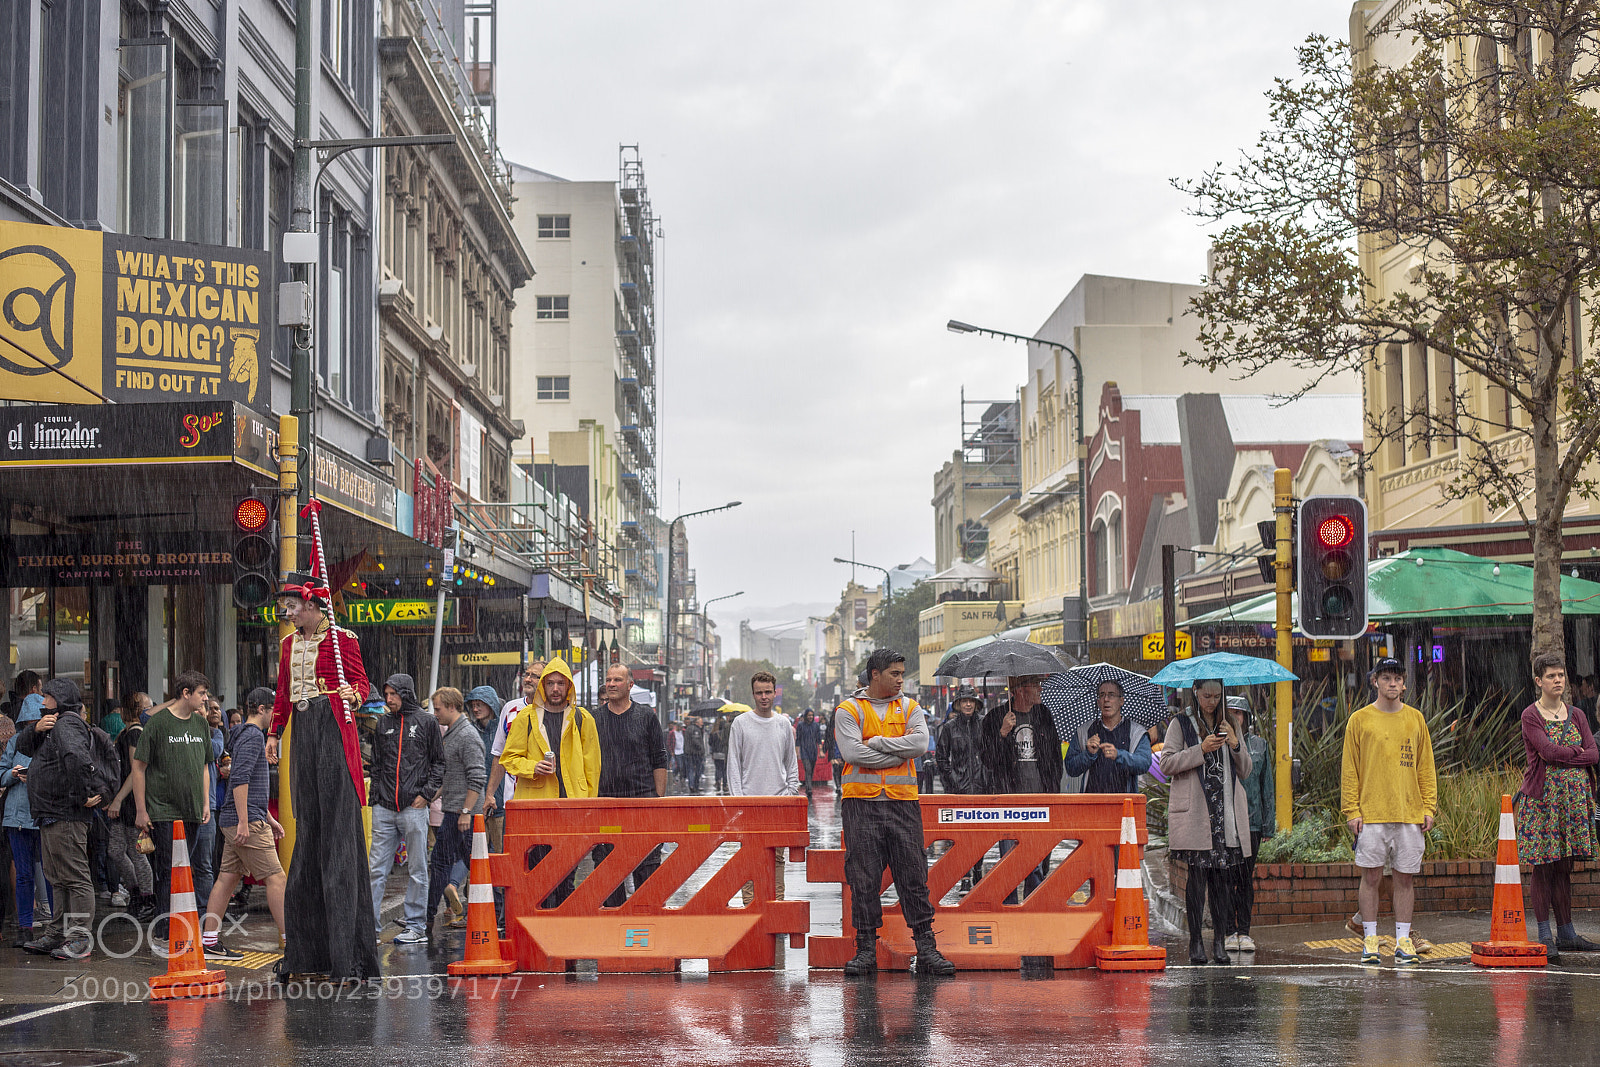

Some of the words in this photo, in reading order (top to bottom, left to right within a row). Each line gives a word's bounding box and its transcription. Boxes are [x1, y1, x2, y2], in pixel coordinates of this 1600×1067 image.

[317, 150, 329, 159] W
[116, 250, 205, 283] WHAT'S
[211, 261, 260, 288] THIS
[116, 276, 259, 324] MEXICAN
[116, 316, 225, 362] DOING?
[116, 370, 154, 391] FIND
[159, 373, 195, 394] OUT
[199, 377, 221, 395] AT
[44, 416, 72, 424] TEQUILA
[8, 422, 23, 450] el
[252, 419, 263, 438] THE
[116, 541, 142, 550] THE
[18, 555, 75, 567] FLYING
[81, 553, 151, 567] BURRITO
[156, 552, 233, 564] BROTHER
[59, 570, 111, 578] CANTINA
[132, 569, 201, 577] TEQUILERIA
[346, 602, 386, 624] TEAS
[962, 611, 979, 620] SAN
[1148, 640, 1187, 653] SUHI
[1219, 634, 1267, 649] Pierre's
[955, 810, 1000, 820] Fulton
[1003, 810, 1047, 821] Hogan
